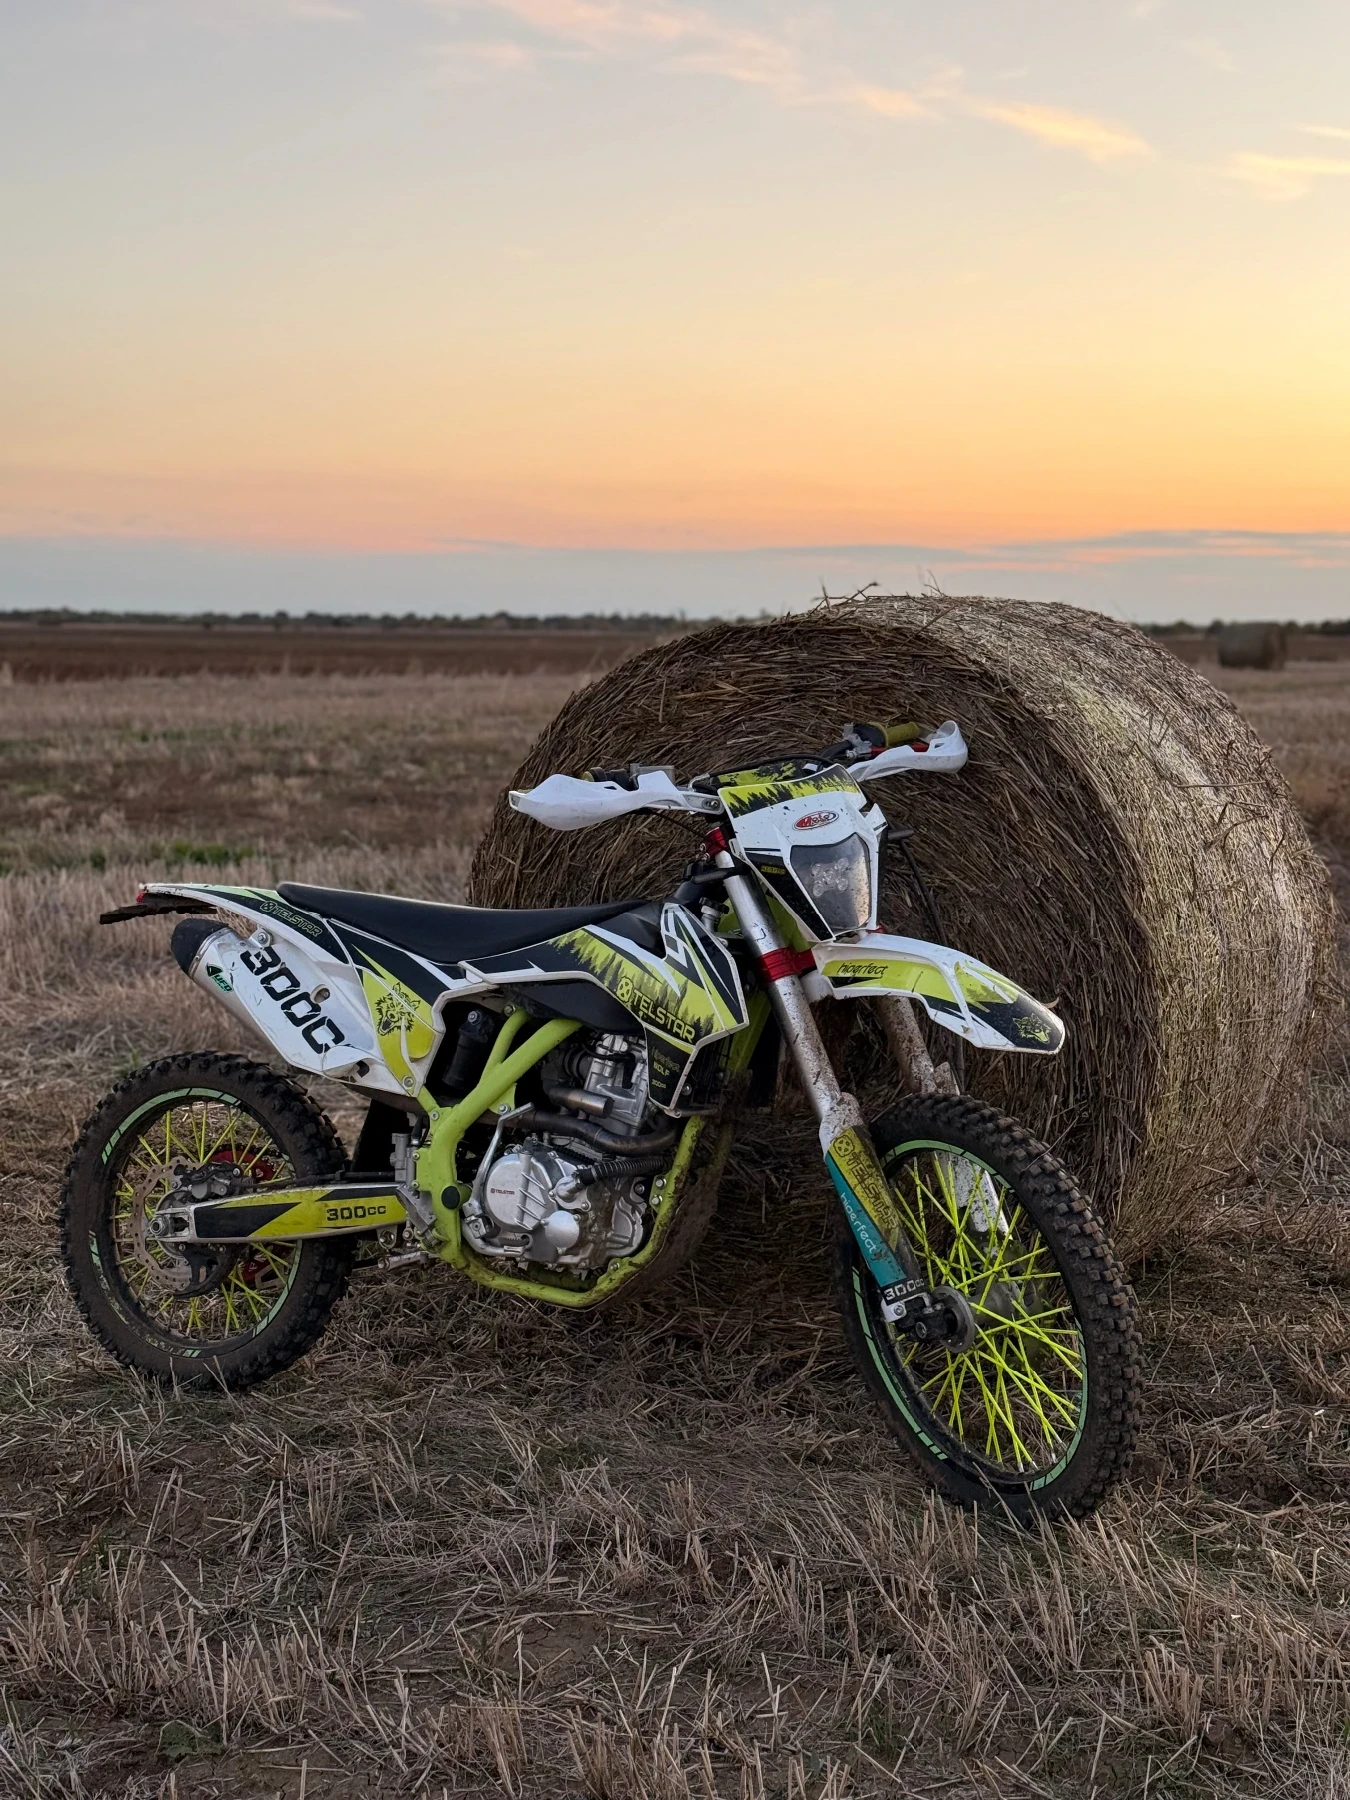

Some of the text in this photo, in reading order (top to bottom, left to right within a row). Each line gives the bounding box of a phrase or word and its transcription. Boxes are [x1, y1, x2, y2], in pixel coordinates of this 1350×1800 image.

[273, 906, 323, 937] TELSTAR
[212, 974, 233, 992] UFO
[633, 988, 696, 1043] TELSTAR
[847, 1151, 898, 1230] TELSTAR
[327, 1206, 387, 1221] 300cc
[883, 1278, 925, 1301] 300cc
